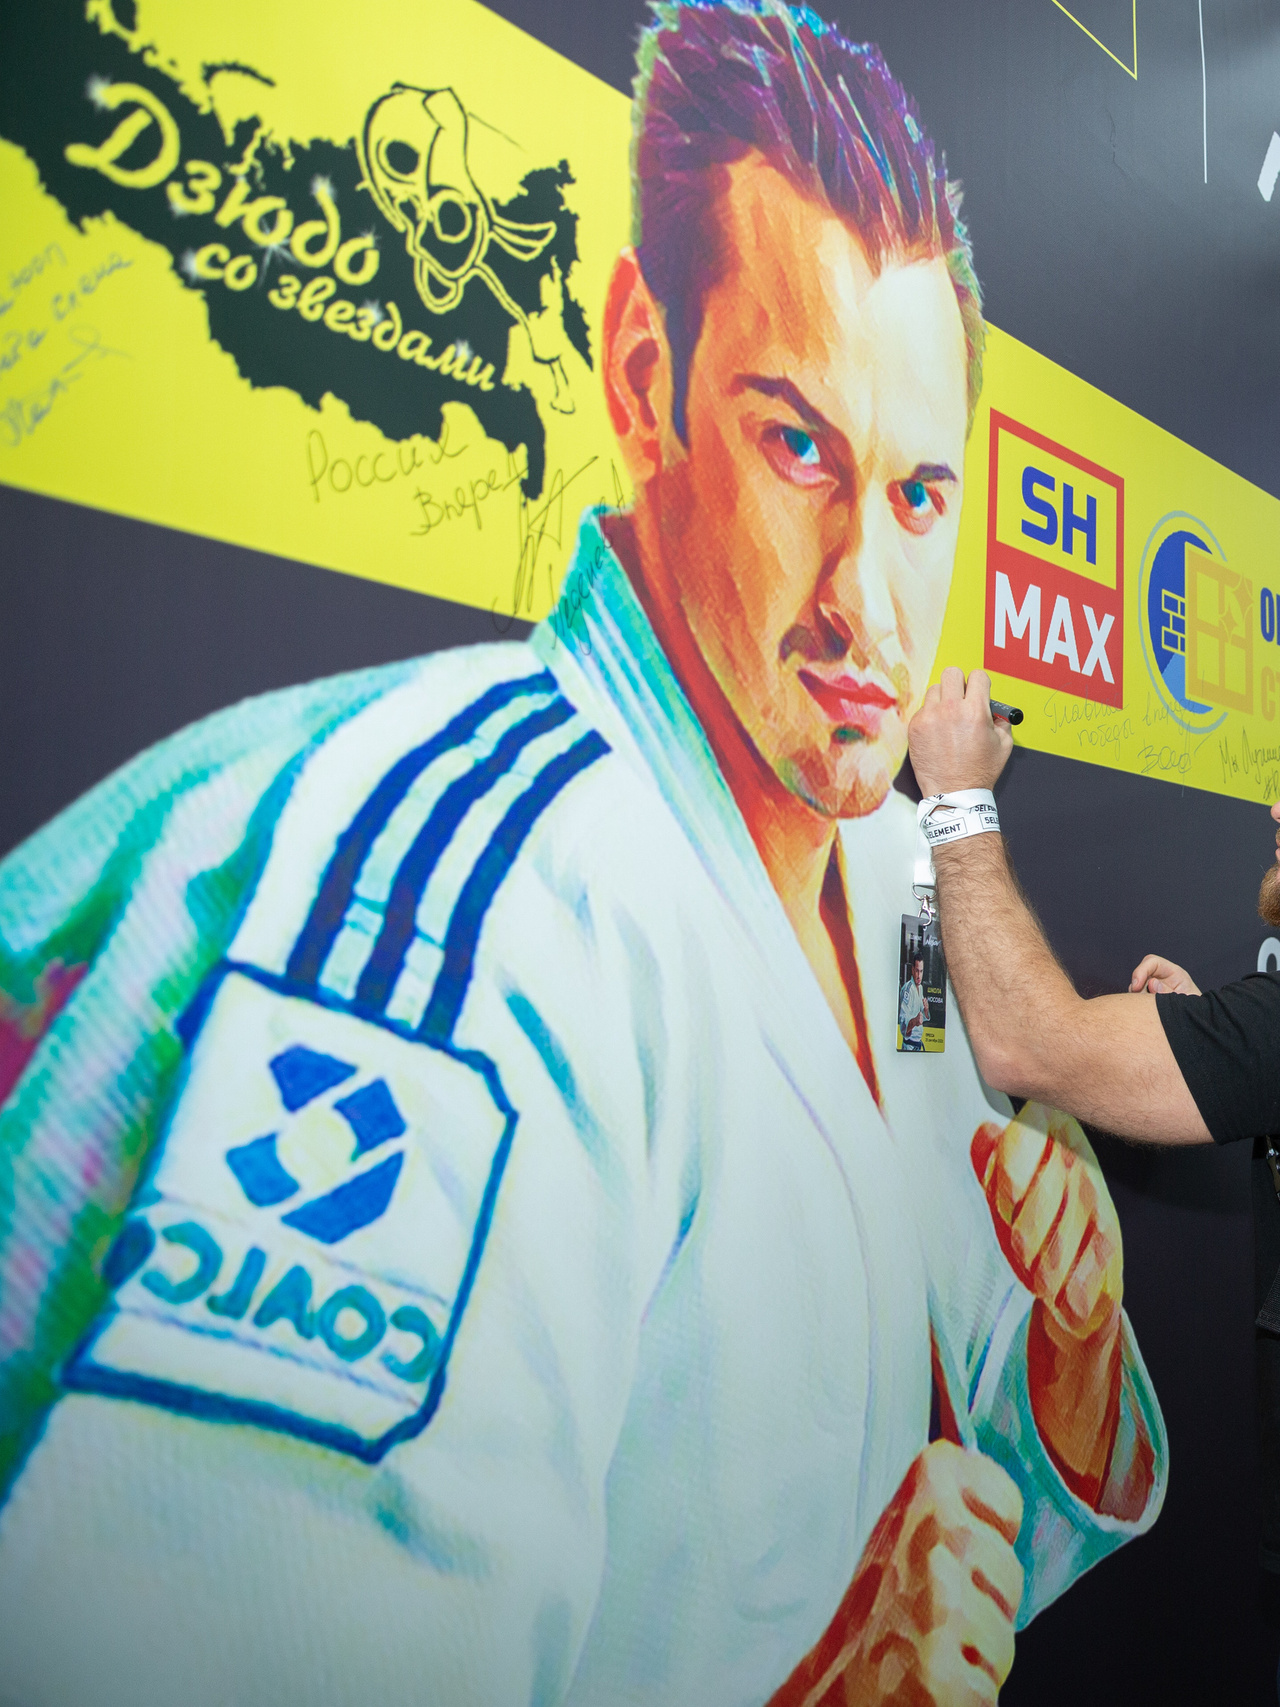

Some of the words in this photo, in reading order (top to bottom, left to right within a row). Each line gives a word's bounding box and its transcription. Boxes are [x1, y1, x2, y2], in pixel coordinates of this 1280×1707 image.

[65, 82, 380, 286] Дзюдо
[193, 243, 257, 290] со
[268, 273, 495, 391] звездами
[1021, 465, 1097, 566] SH
[994, 570, 1116, 685] MAX
